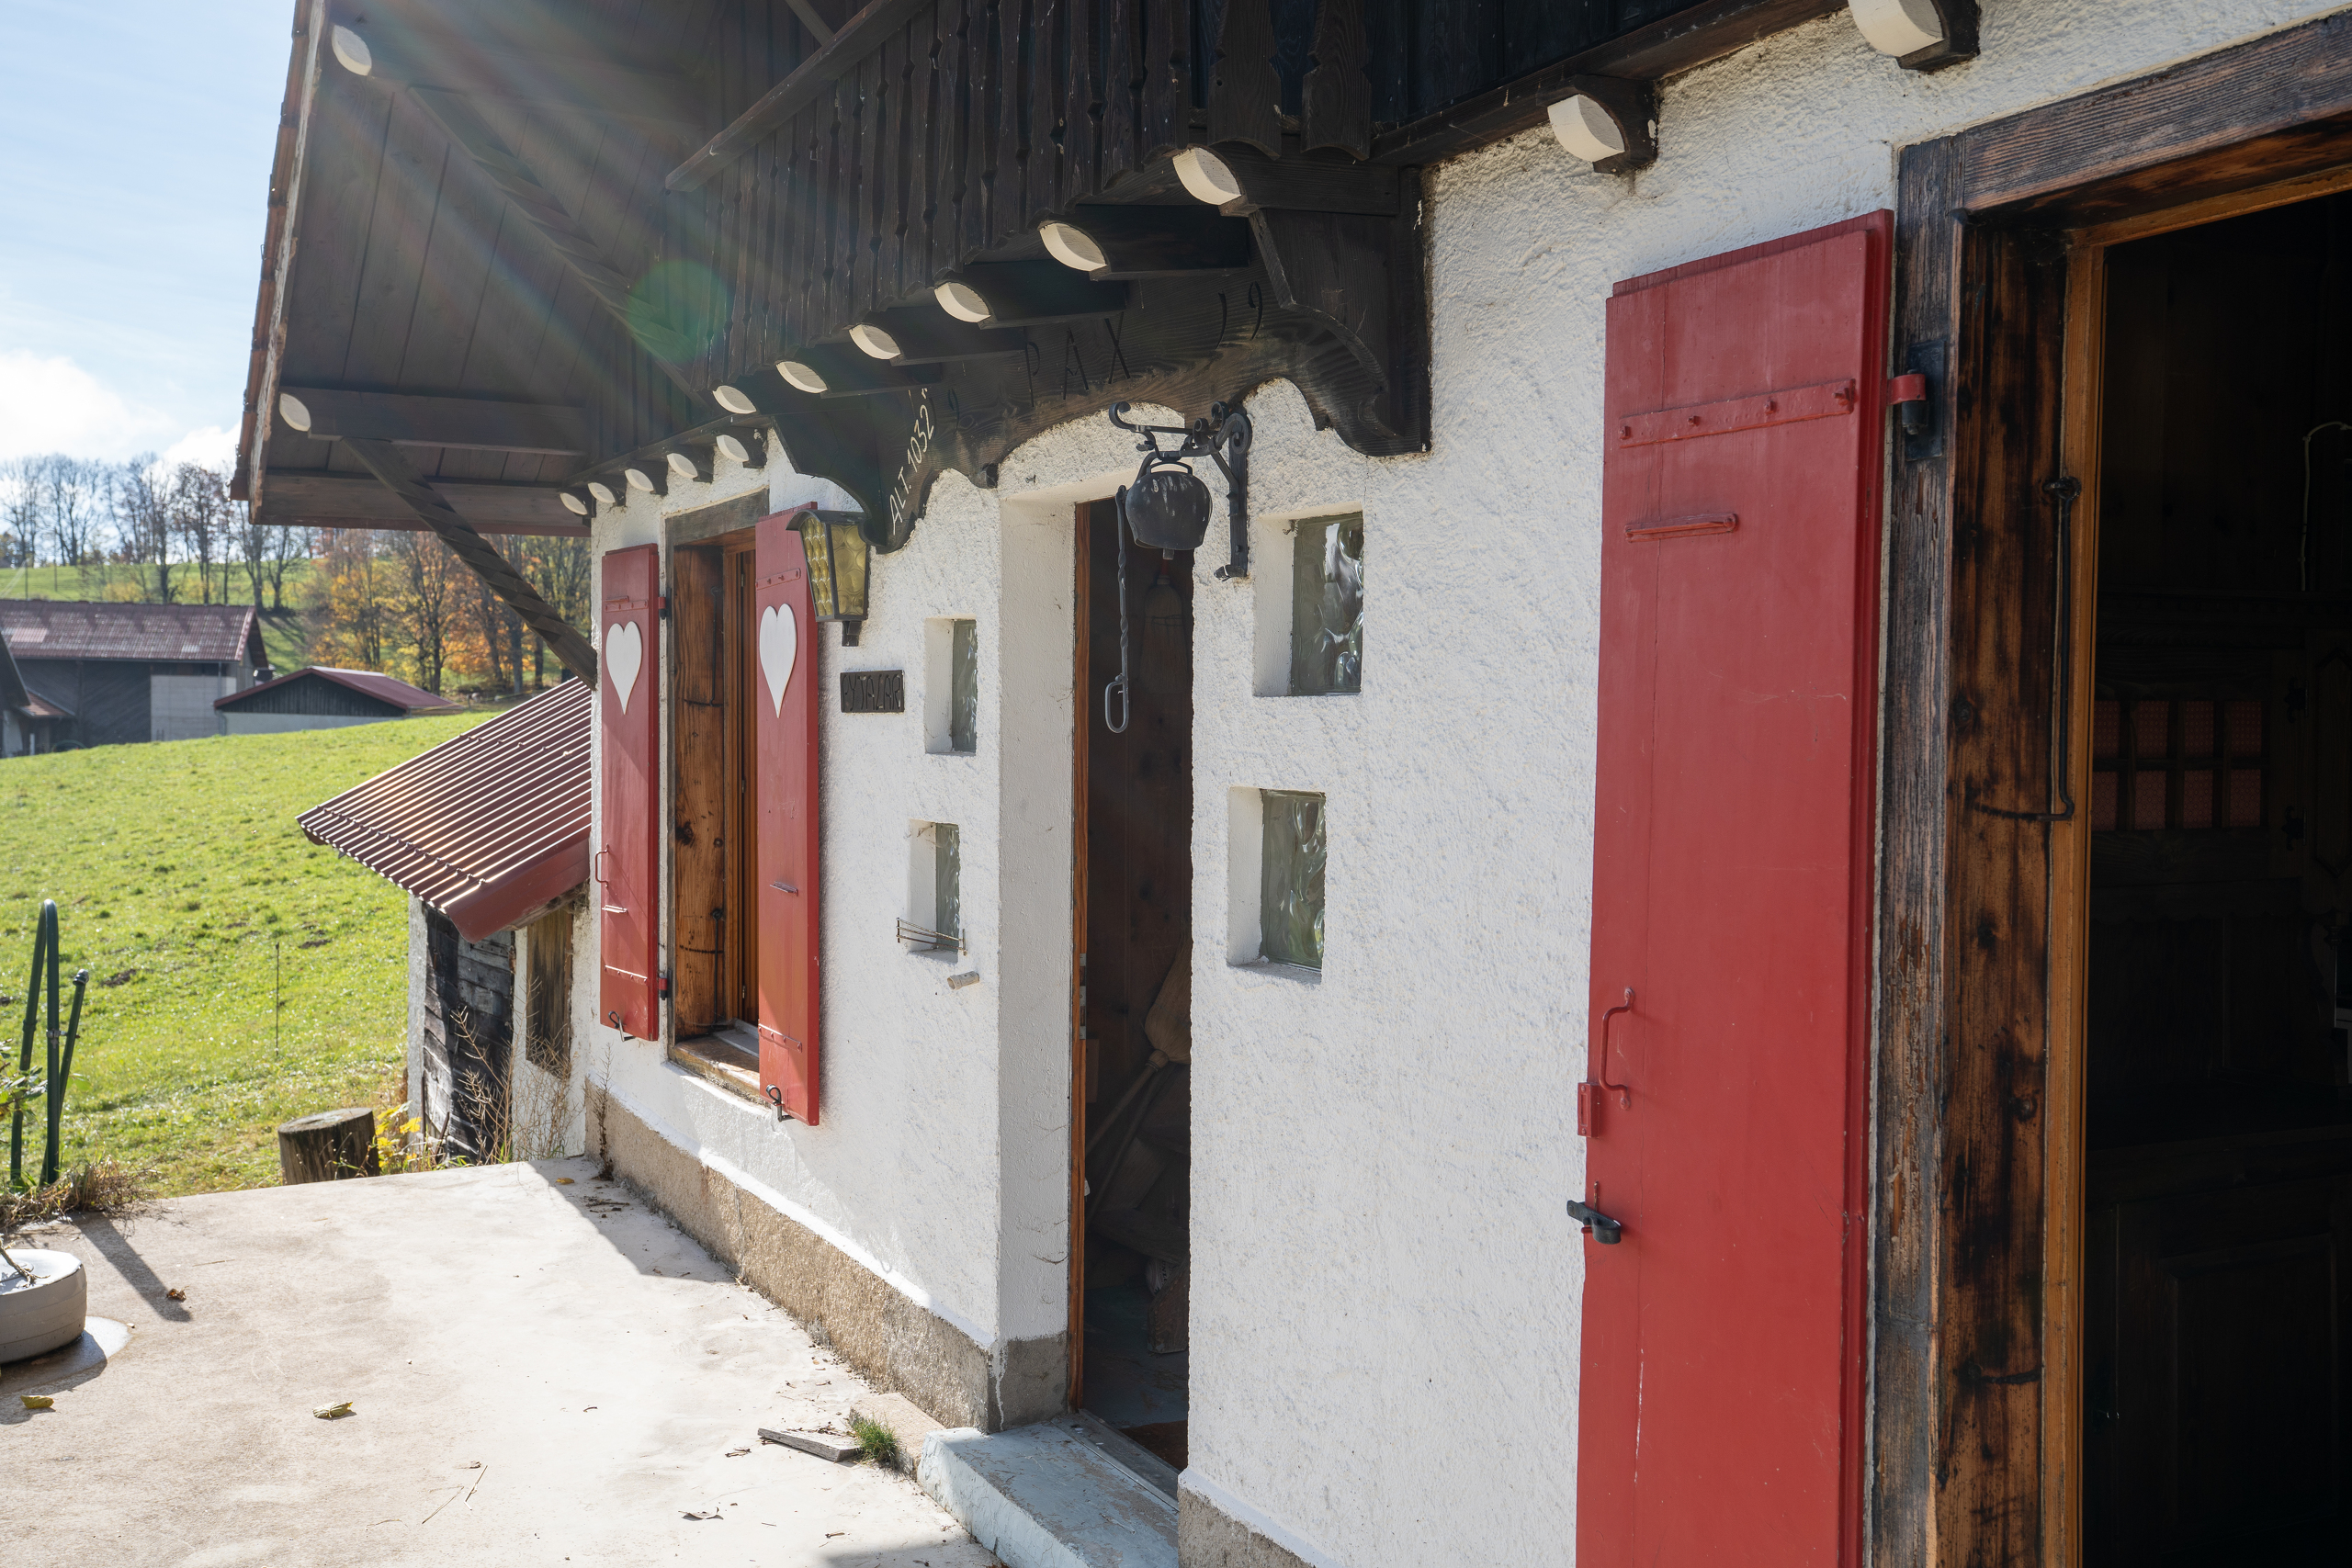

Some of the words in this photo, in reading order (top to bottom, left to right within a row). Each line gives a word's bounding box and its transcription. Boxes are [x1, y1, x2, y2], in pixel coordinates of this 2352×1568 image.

[1023, 310, 1131, 408] PAX
[888, 465, 912, 536] ALT.
[906, 404, 935, 473] 1032
